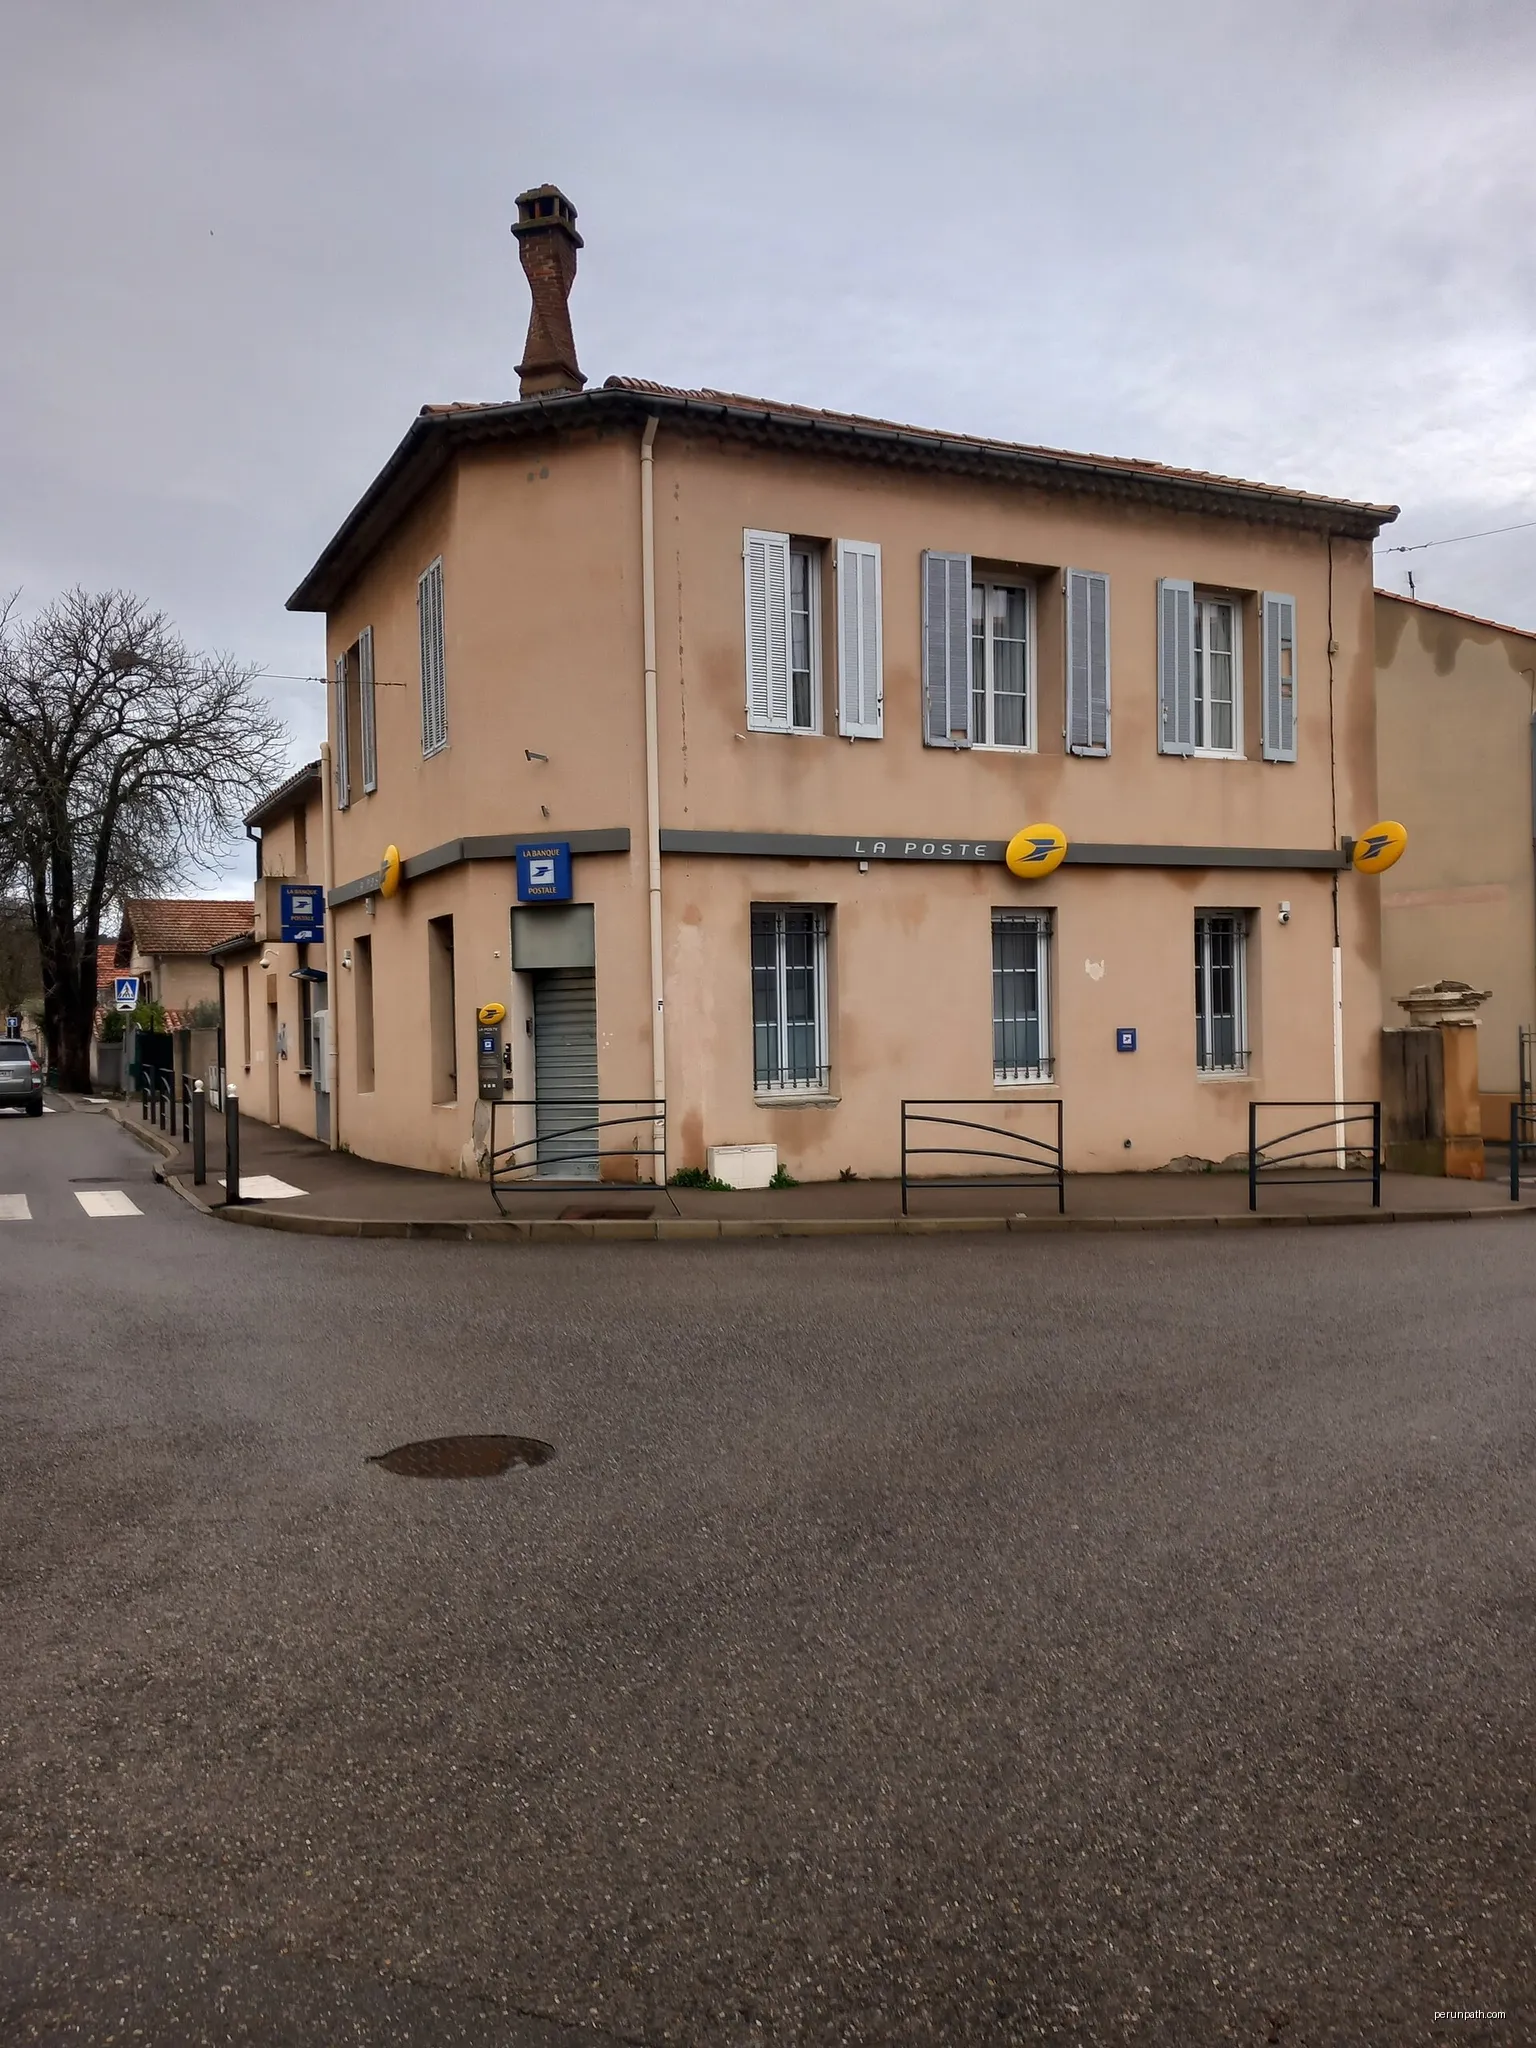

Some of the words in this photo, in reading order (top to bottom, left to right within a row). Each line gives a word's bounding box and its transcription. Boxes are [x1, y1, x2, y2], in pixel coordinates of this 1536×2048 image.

[523, 850, 531, 858] LA
[532, 848, 560, 857] BANQUE
[856, 841, 886, 853] LA
[904, 842, 987, 856] POSTE
[528, 887, 557, 895] POSTALE
